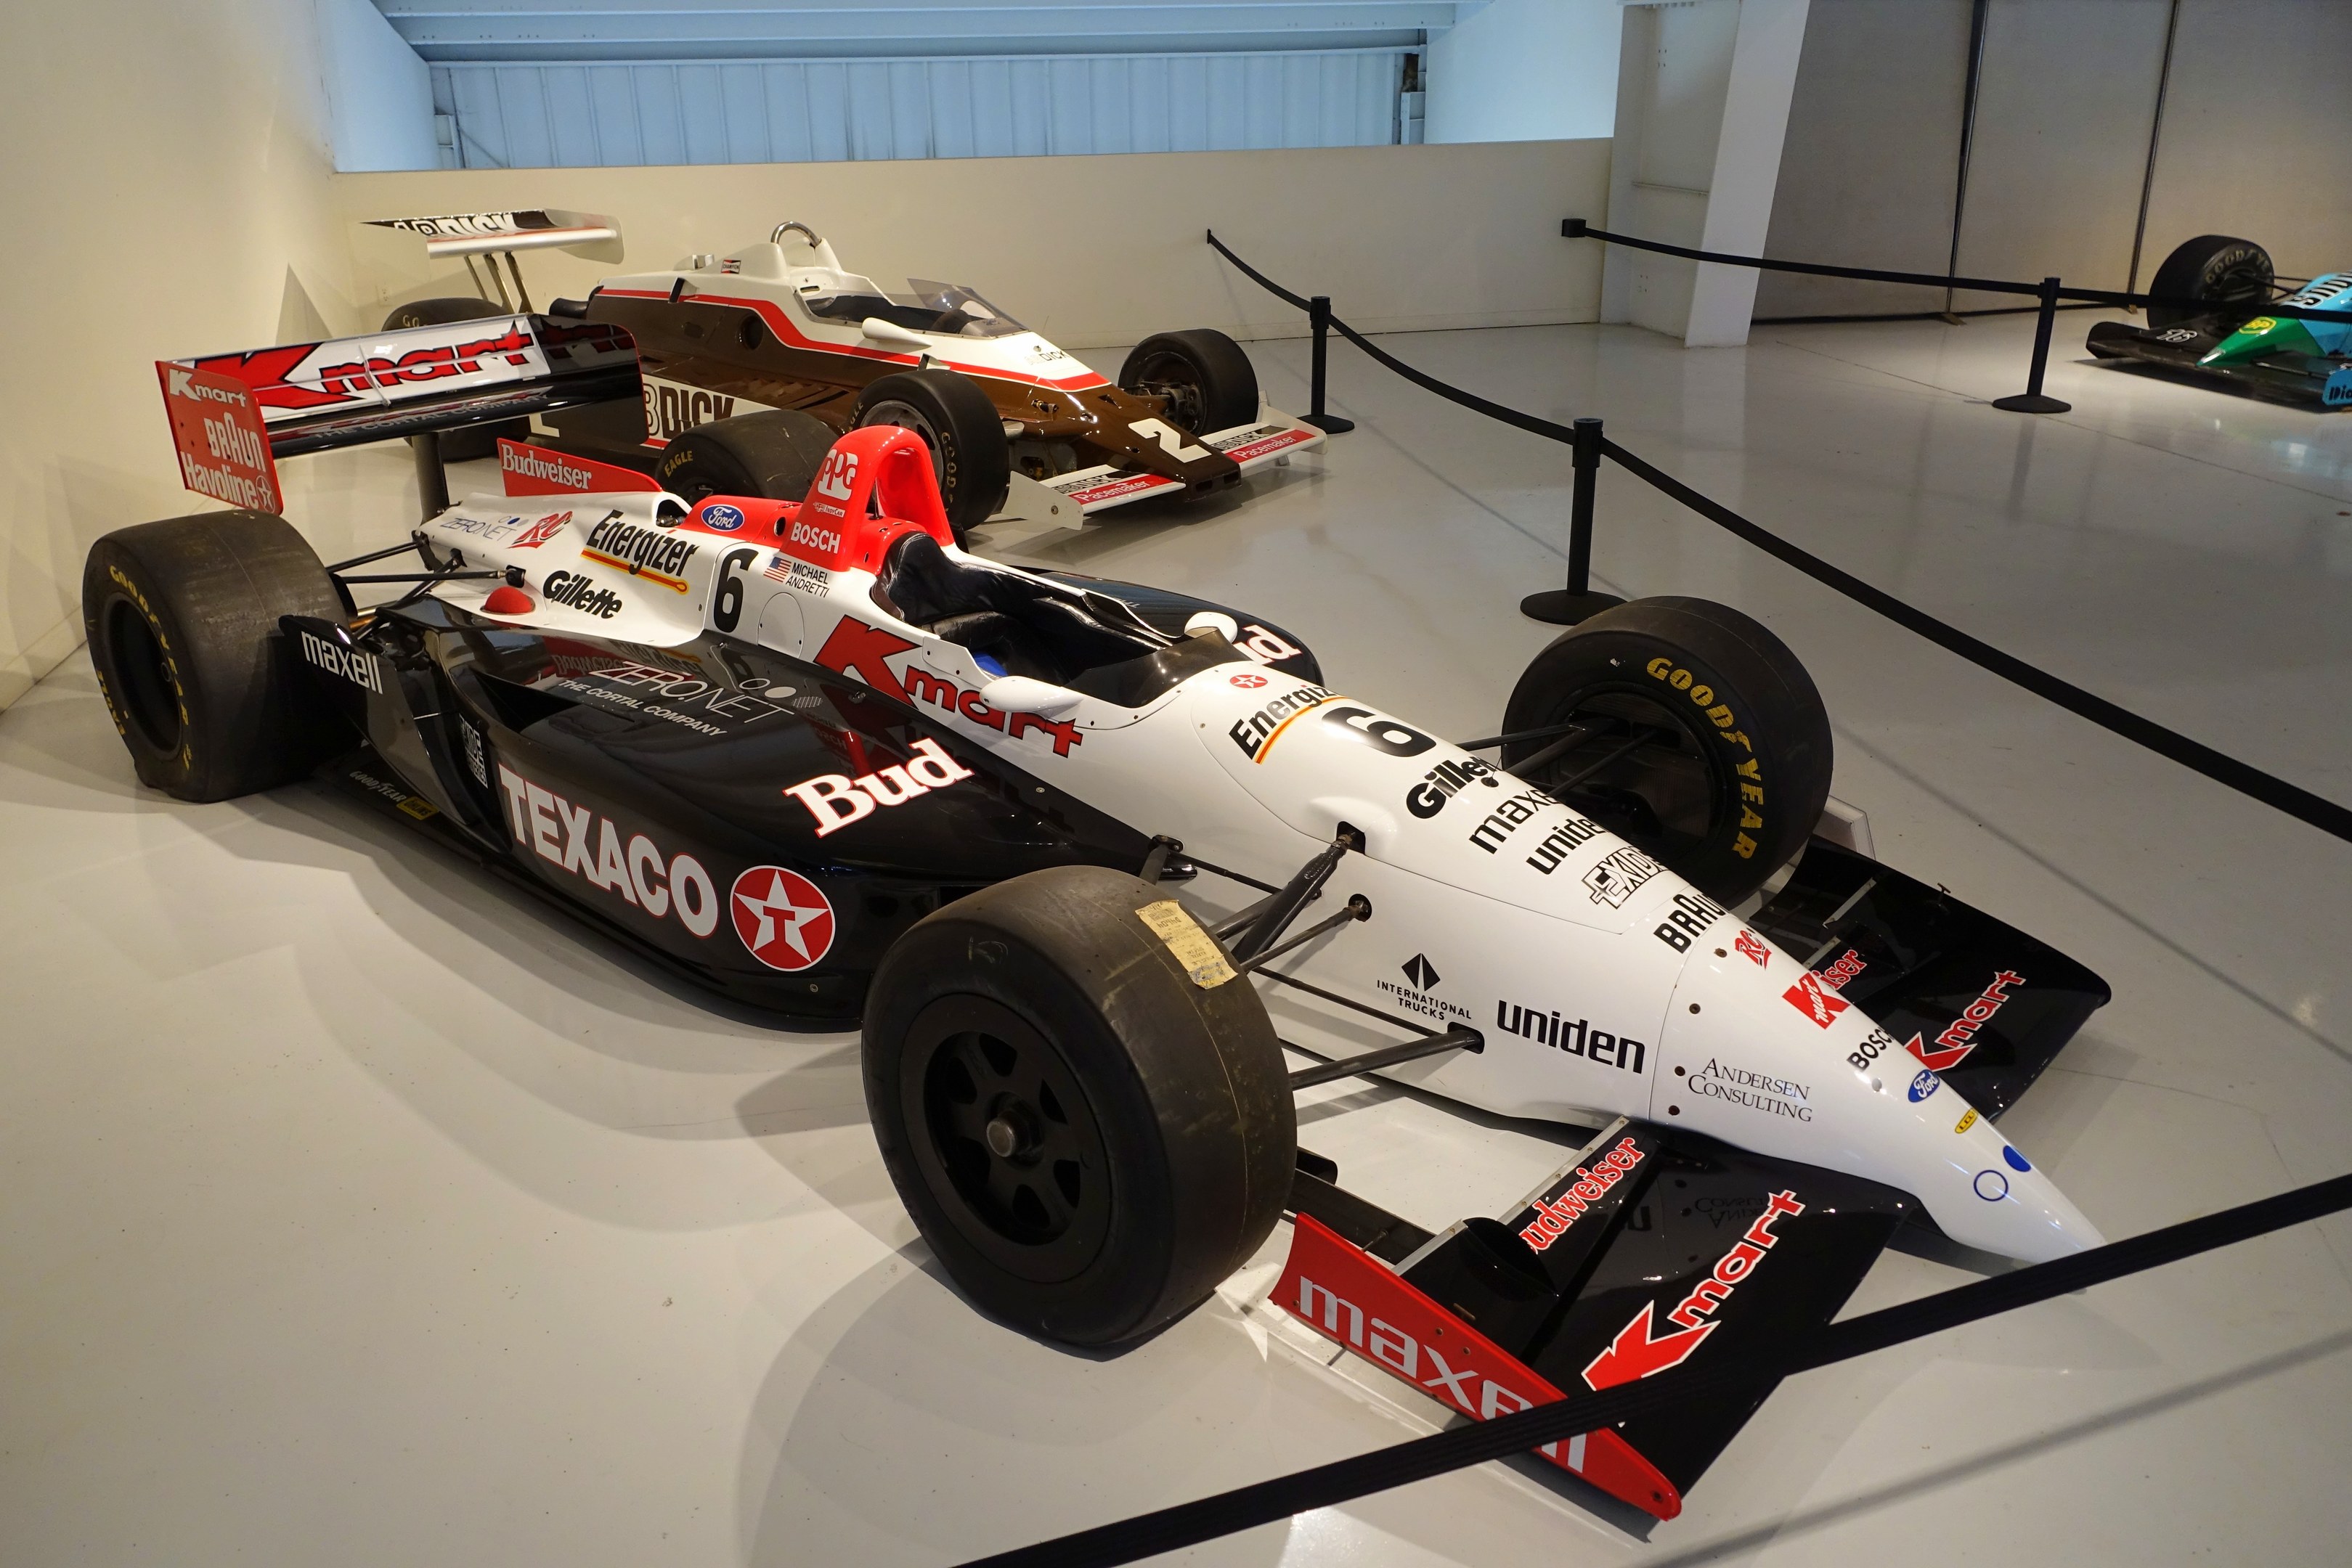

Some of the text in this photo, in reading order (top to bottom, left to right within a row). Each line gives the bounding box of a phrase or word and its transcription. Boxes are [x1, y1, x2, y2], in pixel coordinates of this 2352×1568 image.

[168, 368, 247, 407] Kmart
[195, 320, 534, 409] Kmart
[203, 412, 266, 472] BRAUN
[501, 443, 593, 490] Budweiser
[664, 450, 694, 478] EAGLE
[1128, 417, 1212, 462] 2
[1233, 436, 1297, 459] Pacemaker
[180, 451, 260, 510] Havoline
[1074, 480, 1151, 502] Pacemaker
[586, 509, 700, 577] Energizer
[707, 506, 738, 529] Ford
[791, 521, 842, 554] BOSCH
[543, 570, 623, 618] Gillette
[714, 547, 760, 632] 6
[786, 576, 830, 598] ANDRETTI
[792, 562, 829, 584] MICHAEL
[301, 630, 383, 694] maxell
[813, 613, 1083, 759] Kmart
[558, 679, 728, 737] THE CORTAL COMPANY
[1229, 685, 1338, 759] Energiz
[1322, 706, 1436, 757] 6
[783, 738, 974, 838] Bud
[1407, 756, 1502, 819] Gillet
[498, 762, 719, 938] TEXACO
[1469, 789, 1561, 854] maxe
[1526, 819, 1608, 875] unide
[1582, 846, 1669, 910] EXID
[1653, 894, 1728, 954] BRAU
[1377, 979, 1472, 1020] INTERNATIONAL
[1398, 997, 1446, 1021] TRUCKS
[1905, 970, 2026, 1072] Kmart
[1497, 1000, 1645, 1074] uniden
[1847, 1026, 1895, 1073] BOSC
[1688, 1074, 1813, 1122] CONSULTING
[1701, 1058, 1811, 1101] ANDERSEN
[1913, 1071, 1939, 1098] Ford
[1518, 1137, 1645, 1254] udweiser
[1581, 1189, 1806, 1391] Kmart
